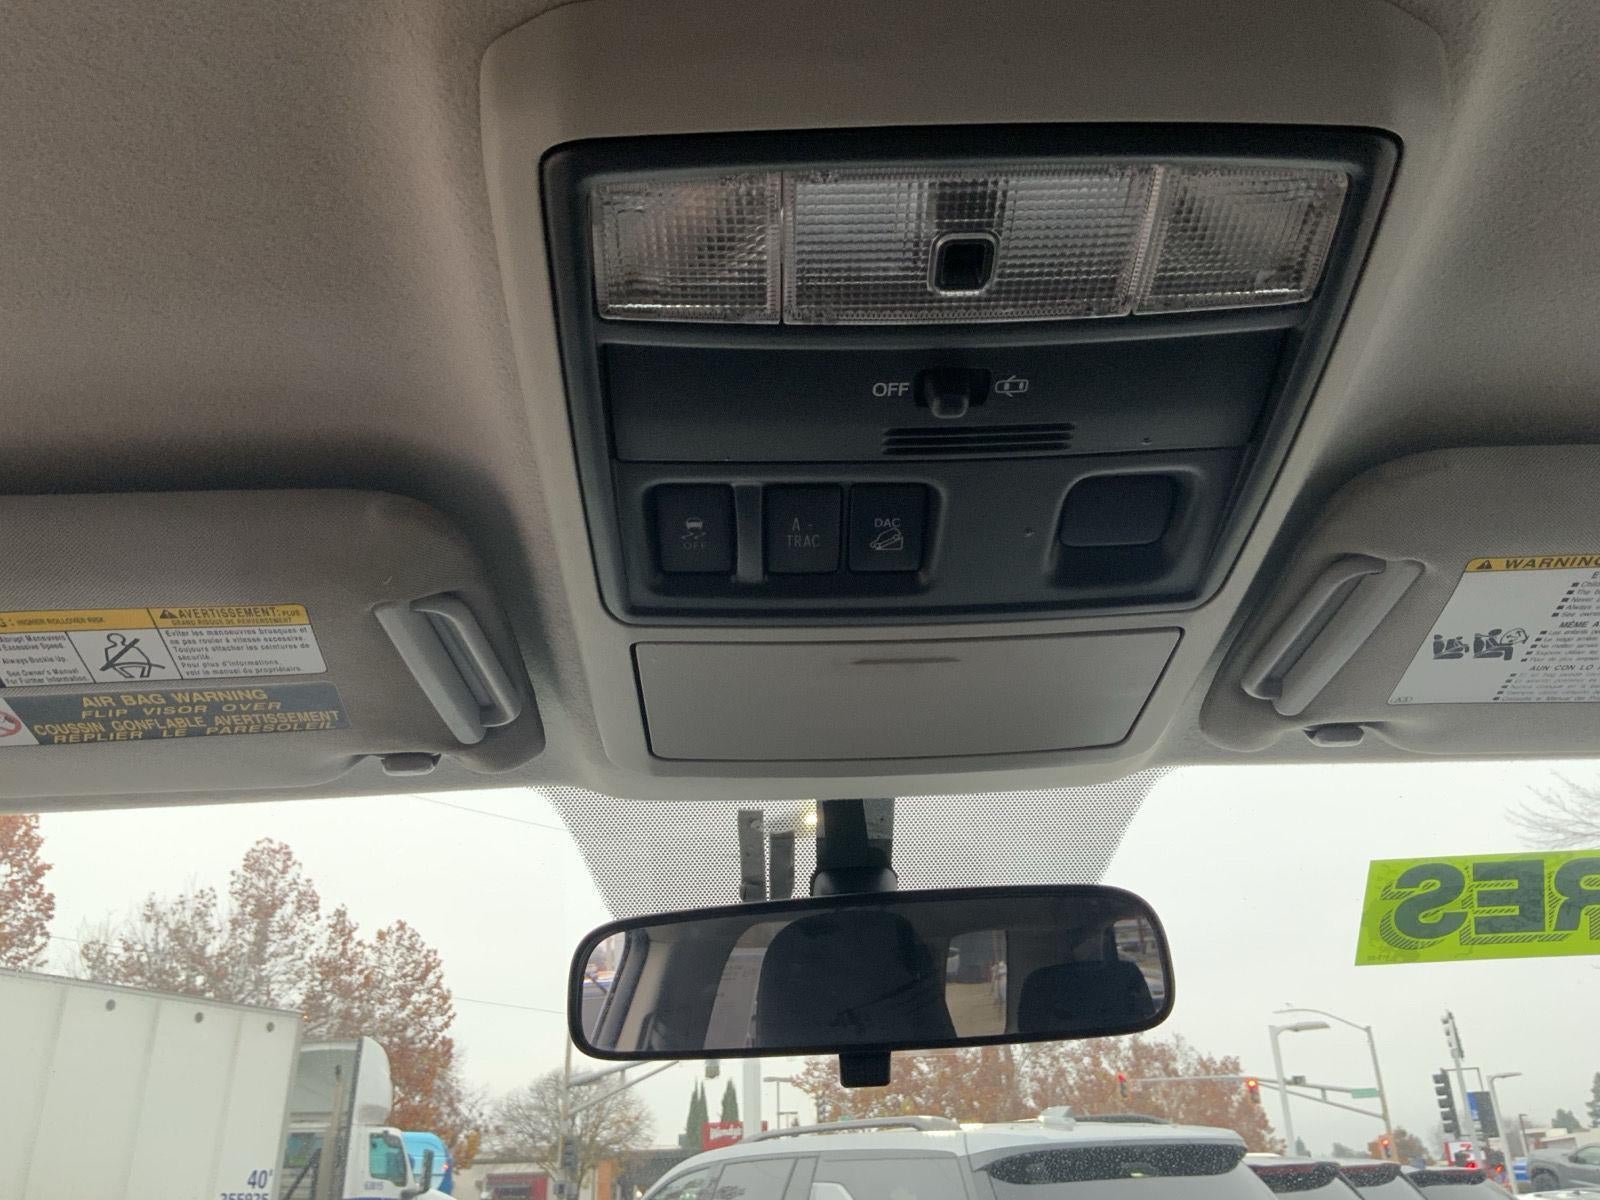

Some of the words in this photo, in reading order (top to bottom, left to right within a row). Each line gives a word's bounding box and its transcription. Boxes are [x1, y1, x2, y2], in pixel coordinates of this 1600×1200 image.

[872, 382, 910, 398] OFF
[874, 518, 902, 528] DAC
[787, 534, 820, 547] TRAC
[82, 696, 116, 708] AIR
[120, 693, 166, 706] BAG
[171, 688, 268, 703] WARNING
[81, 709, 128, 719] FLIP
[143, 705, 208, 716] VISOR
[222, 702, 282, 712] OVER
[33, 721, 106, 736] COUSSIN
[112, 716, 207, 732] GONFLABLE
[214, 710, 340, 726] AVERTISSEMENT
[54, 731, 143, 744] REPLIER
[162, 728, 187, 738] LE
